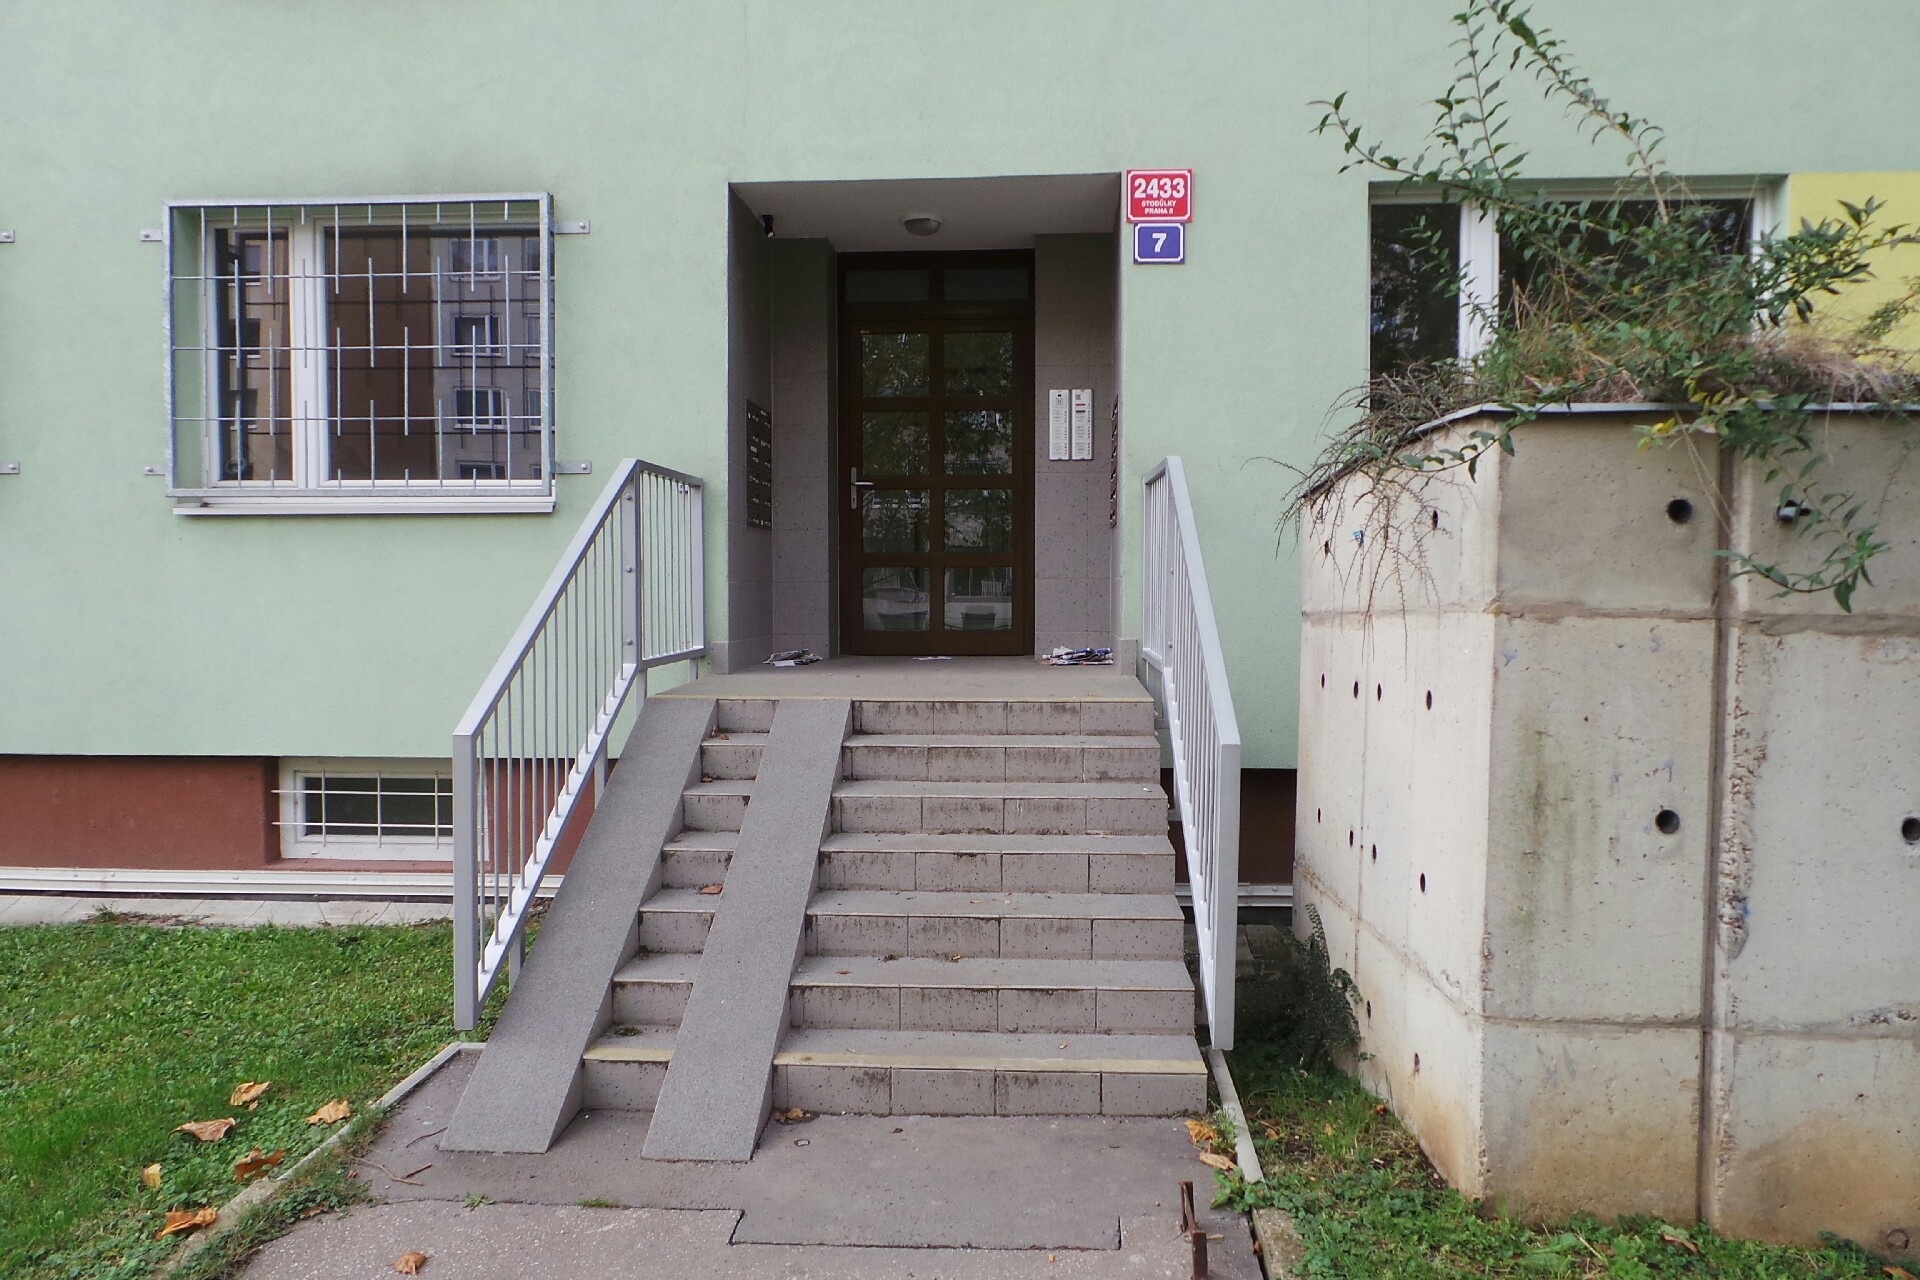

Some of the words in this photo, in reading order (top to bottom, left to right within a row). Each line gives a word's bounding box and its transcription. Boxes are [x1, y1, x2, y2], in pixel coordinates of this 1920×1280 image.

[1134, 178, 1185, 198] 2433
[1142, 199, 1176, 207] STODŮLKY
[1152, 233, 1167, 252] 7
